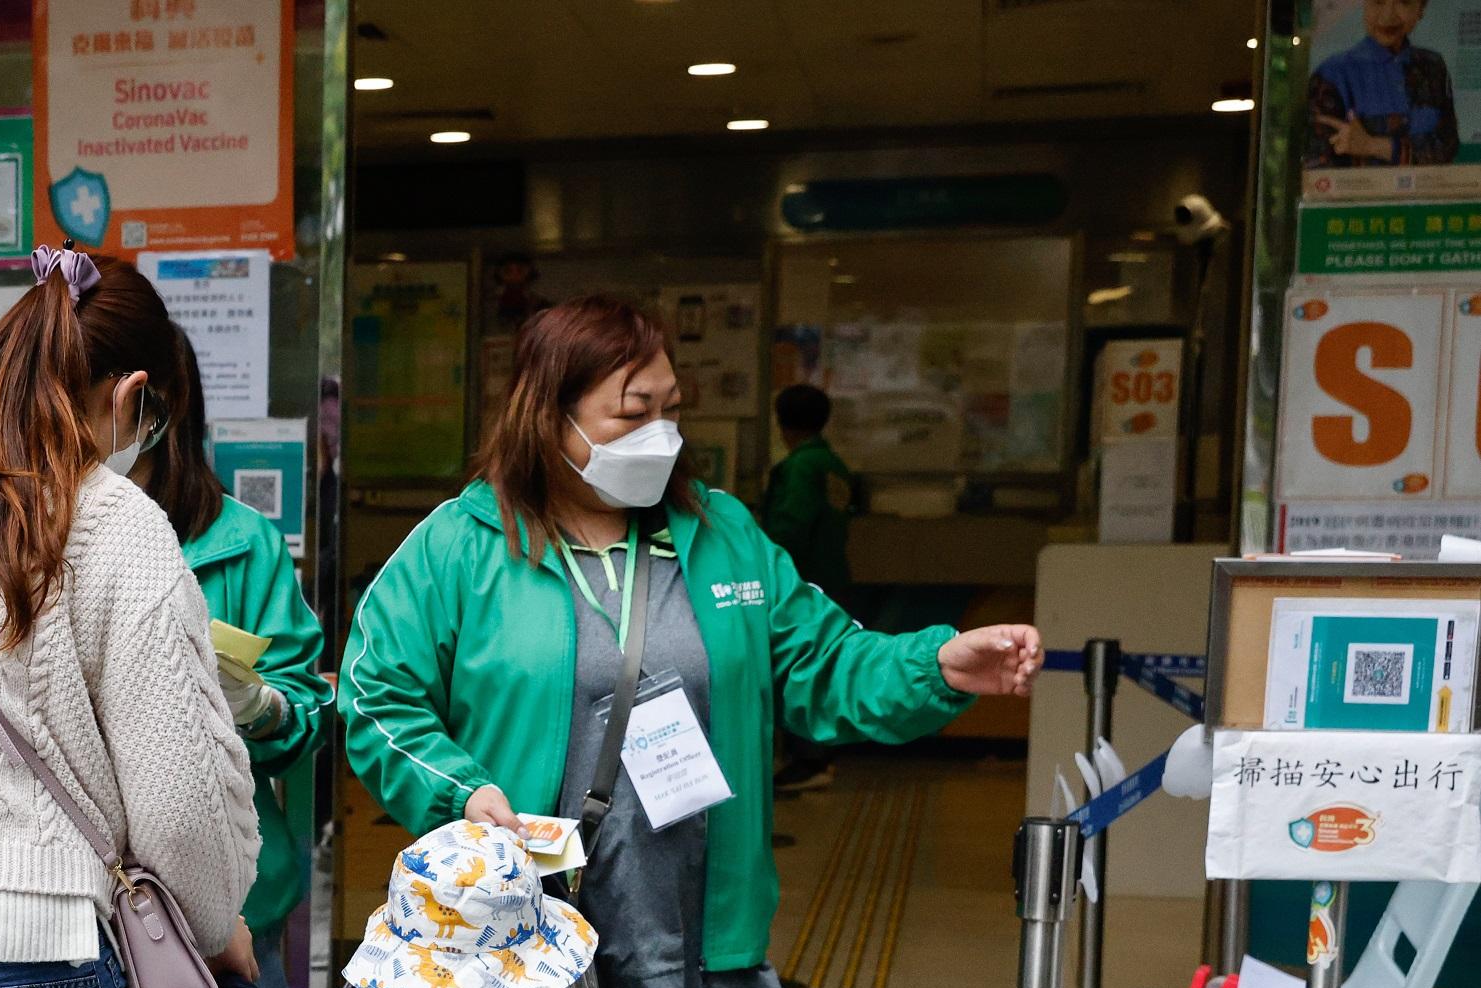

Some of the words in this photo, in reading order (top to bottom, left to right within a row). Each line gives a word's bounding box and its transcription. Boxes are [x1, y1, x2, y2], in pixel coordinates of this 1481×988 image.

[114, 78, 212, 103] Sinovac
[112, 109, 208, 130] CoronaVac
[77, 133, 175, 157] Inactivated
[180, 132, 249, 153] Vaccine
[1325, 253, 1385, 268] PLEASE
[1111, 370, 1176, 405] S03
[1234, 756, 1464, 791] 掃描安心出行
